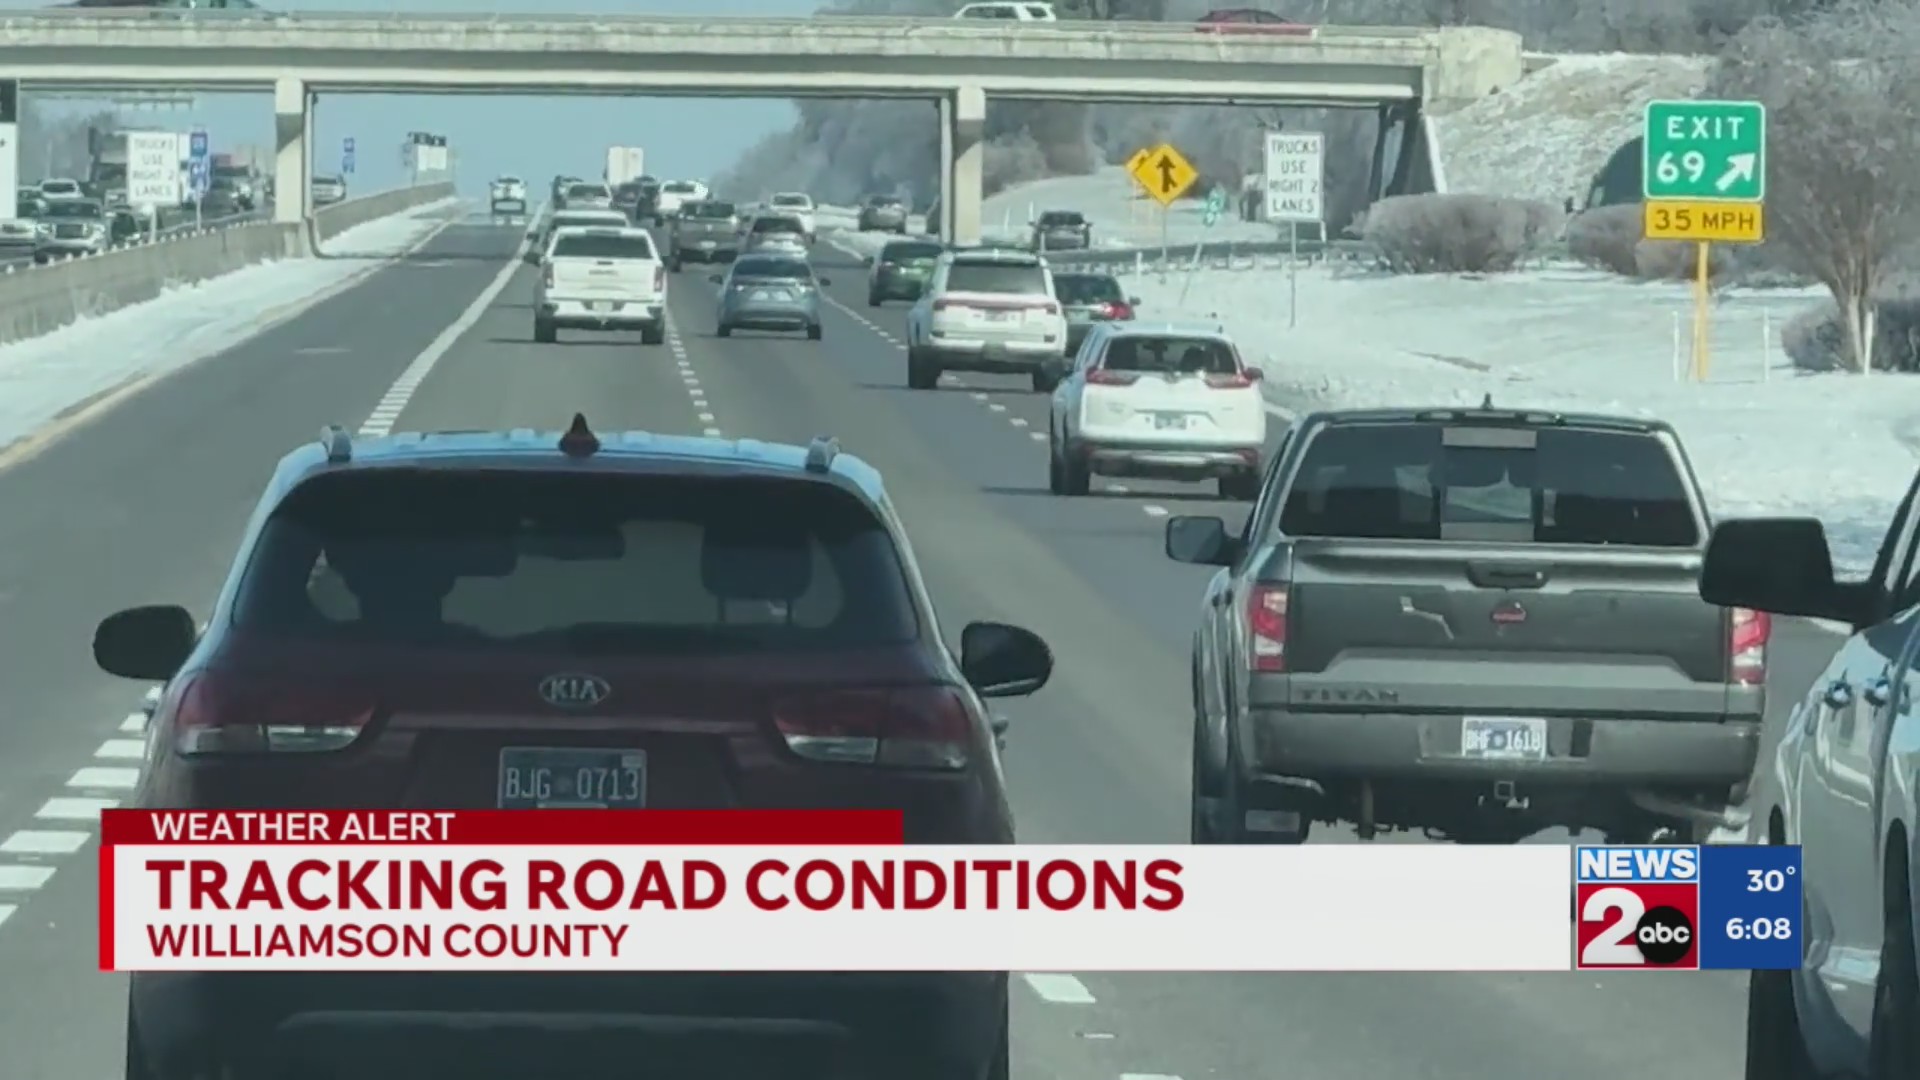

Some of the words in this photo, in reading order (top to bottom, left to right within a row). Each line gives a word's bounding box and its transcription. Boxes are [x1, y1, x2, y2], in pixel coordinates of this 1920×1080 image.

[1667, 115, 1745, 139] EXIT
[1271, 140, 1318, 154] TRUCKS
[1280, 159, 1307, 174] USE
[1656, 150, 1705, 184] 69
[1311, 180, 1319, 193] 2
[1272, 198, 1314, 214] LANES
[1654, 208, 1692, 231] 35
[1701, 211, 1755, 231] MPH
[550, 679, 598, 700] KIA
[1300, 688, 1399, 703] TITAN
[506, 767, 551, 800] BJG
[576, 767, 638, 801] 0713
